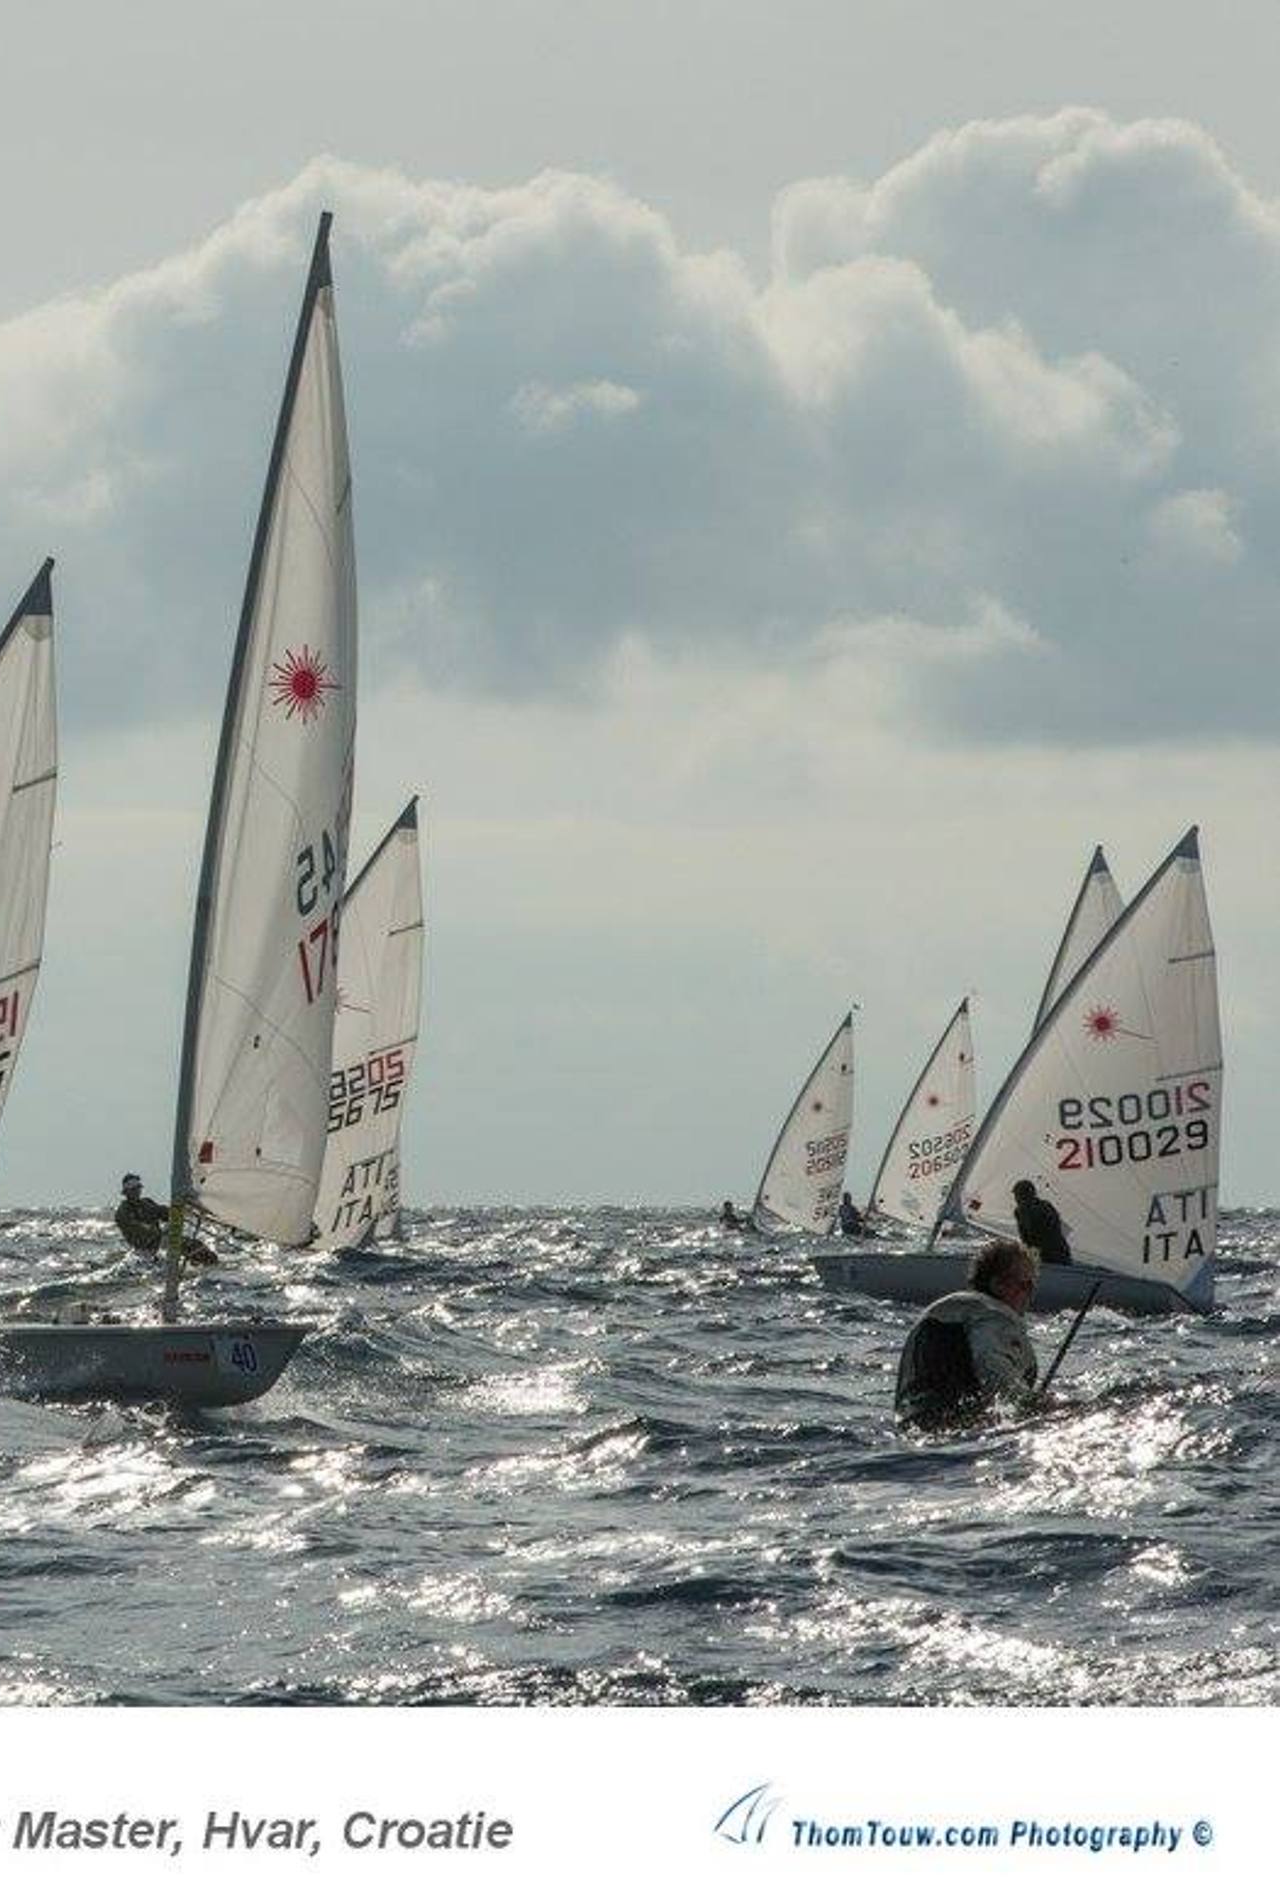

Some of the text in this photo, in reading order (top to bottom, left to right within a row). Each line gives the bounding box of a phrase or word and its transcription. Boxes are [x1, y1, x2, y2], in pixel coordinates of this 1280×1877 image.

[1056, 1119, 1208, 1170] 210029
[332, 1194, 373, 1232] ITA
[1143, 1229, 1205, 1265] ITA
[232, 1342, 258, 1373] 40
